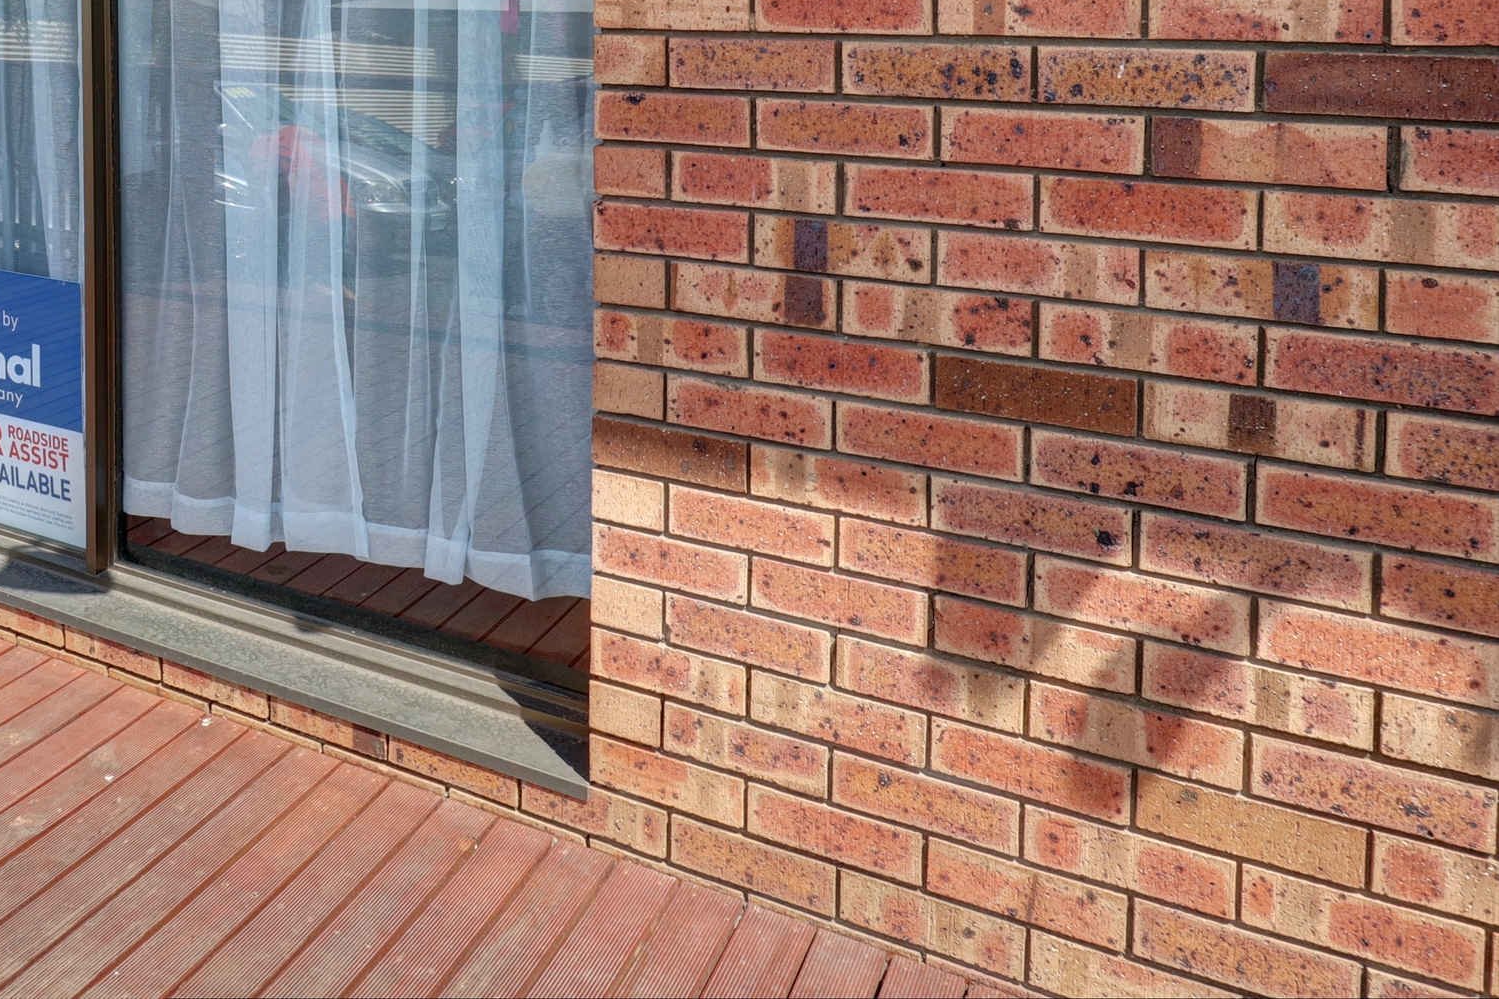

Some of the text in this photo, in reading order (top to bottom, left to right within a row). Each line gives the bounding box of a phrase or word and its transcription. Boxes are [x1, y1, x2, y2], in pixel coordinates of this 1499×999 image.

[2, 309, 19, 332] by
[7, 424, 69, 453] ROADSIDE
[8, 440, 69, 473] ASSIST
